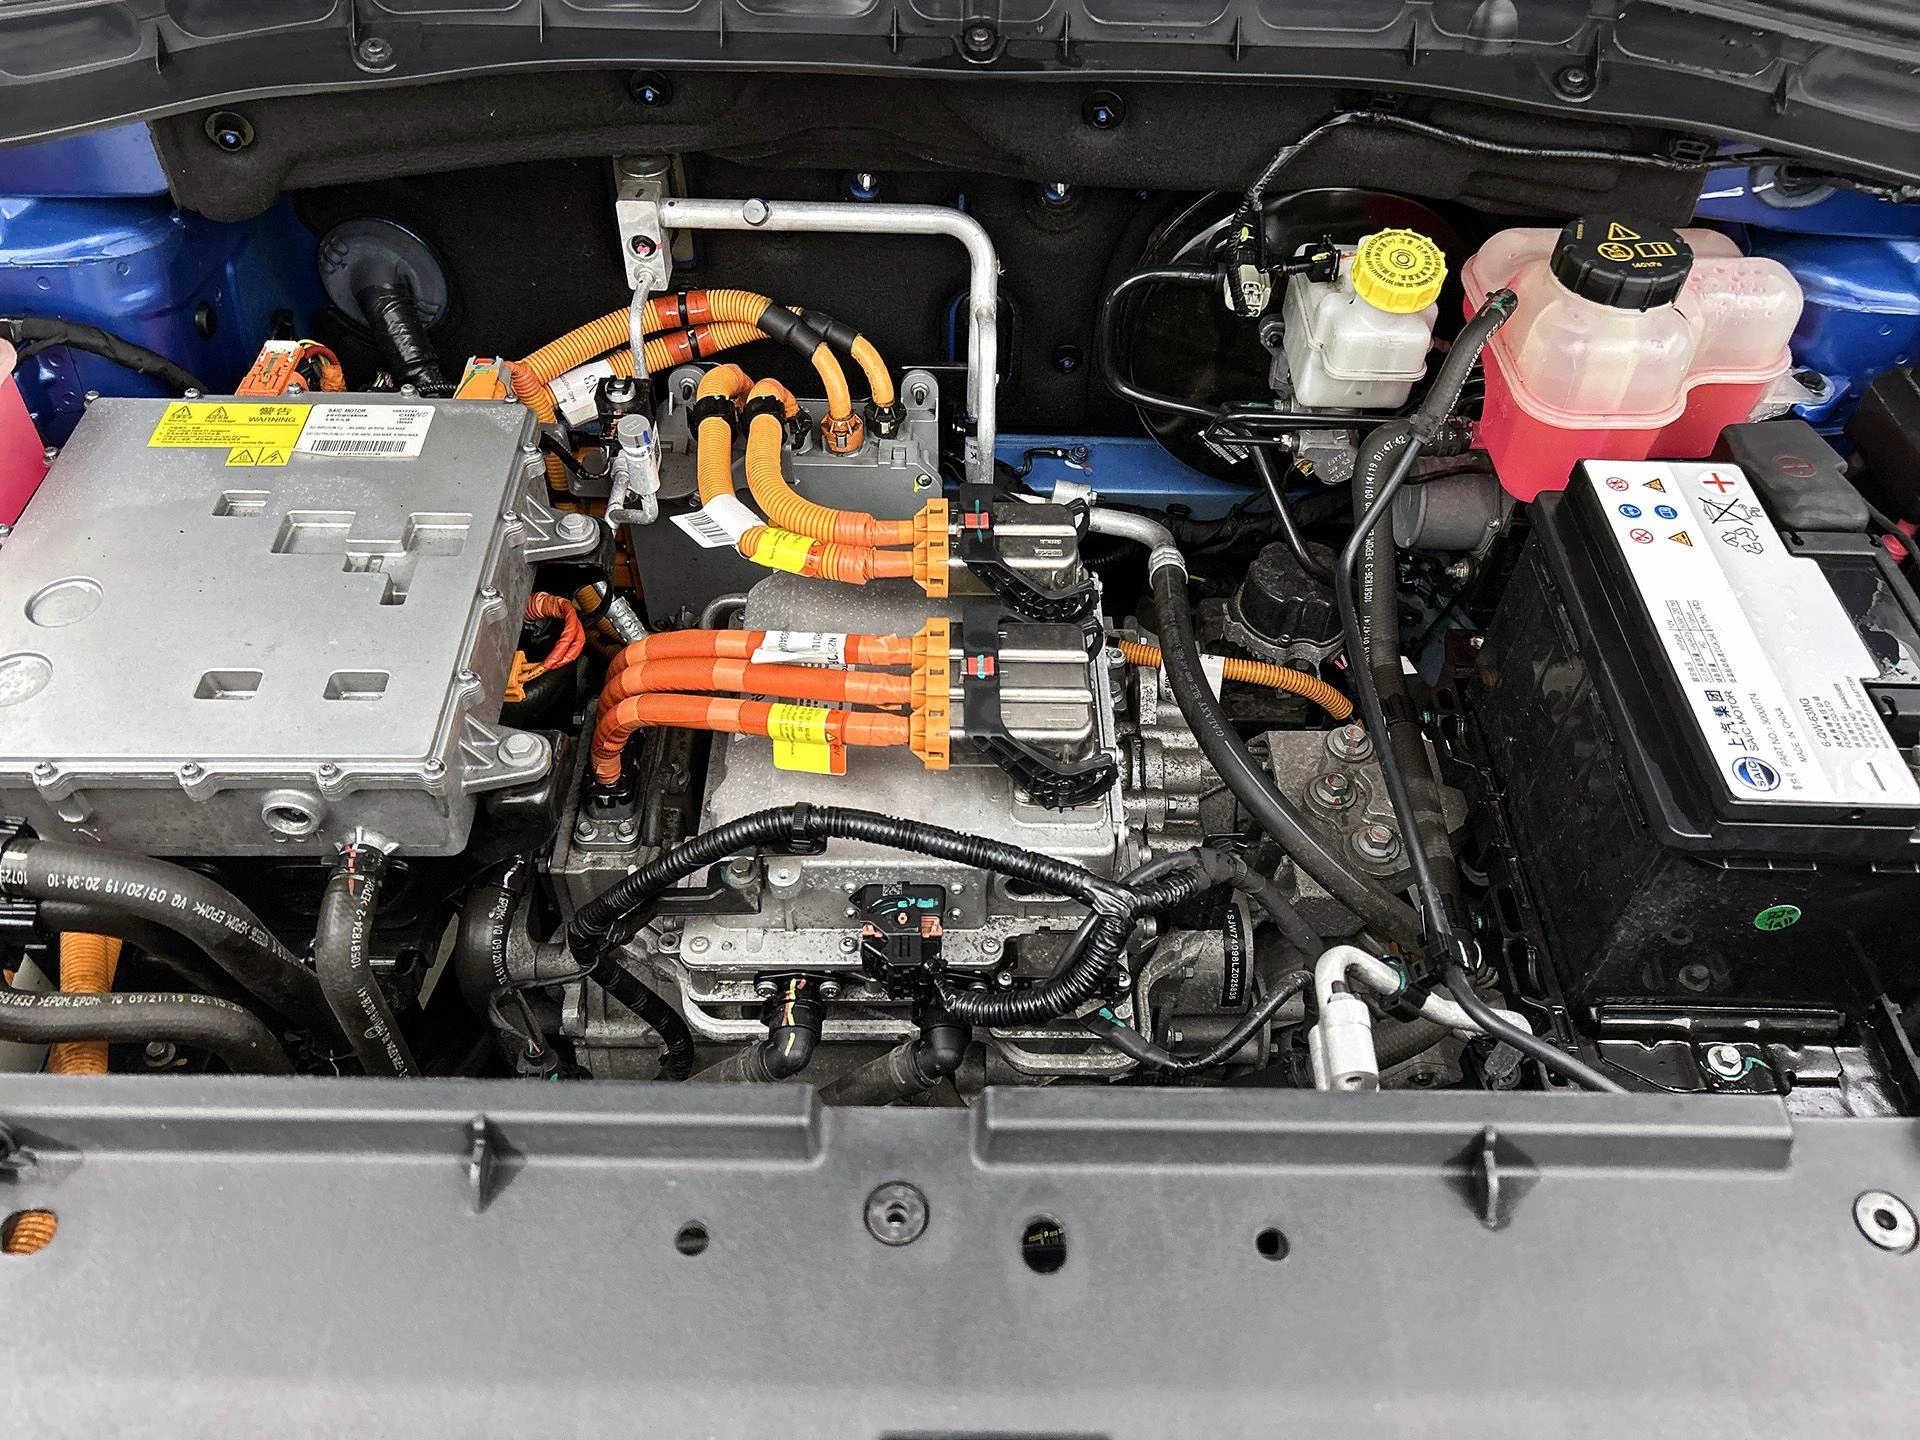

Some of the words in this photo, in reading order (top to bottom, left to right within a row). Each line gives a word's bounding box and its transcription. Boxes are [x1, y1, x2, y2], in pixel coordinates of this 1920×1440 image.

[1373, 435, 1406, 461] 01:47:42
[1750, 507, 1763, 517] Pb
[1190, 684, 1202, 700] SLE
[1722, 690, 1747, 724] MOTOR
[1773, 707, 1791, 728] CHINA
[1200, 702, 1225, 737] GALAXY
[1704, 690, 1748, 751] 上汽集团
[1739, 727, 1760, 751] SAIC
[1773, 747, 1791, 766] PART
[1790, 742, 1808, 762] MADE
[1748, 761, 1766, 787] SAIC
[47, 873, 101, 891] 20:34:10
[104, 878, 167, 903] 09/20/19
[171, 893, 188, 909] VQ
[351, 909, 367, 969] 10581834-2
[493, 924, 504, 935] VQ
[128, 994, 185, 1004] 09/21/19
